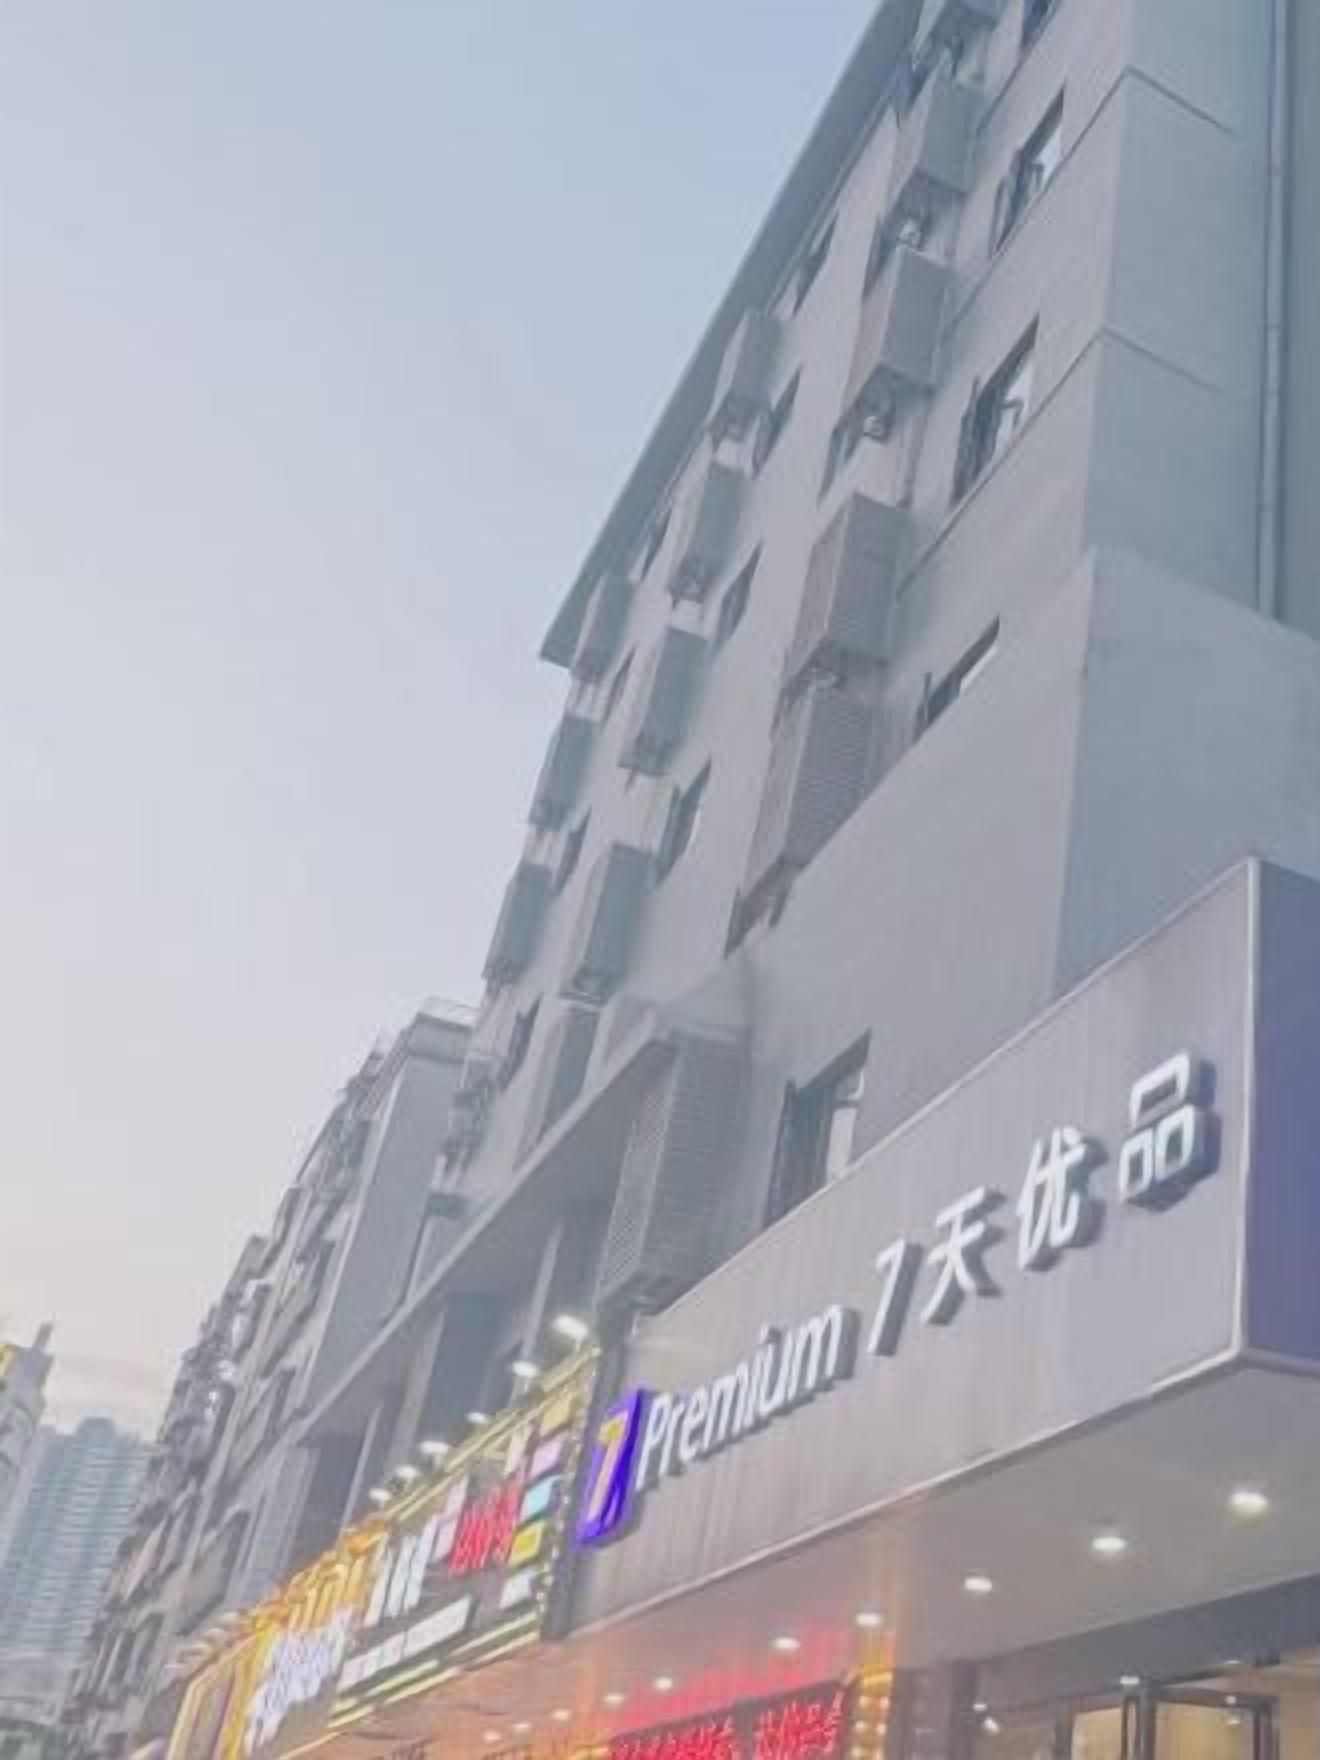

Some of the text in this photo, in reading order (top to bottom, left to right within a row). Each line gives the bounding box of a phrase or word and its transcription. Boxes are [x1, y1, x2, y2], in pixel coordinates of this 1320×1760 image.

[635, 1303, 850, 1491] Premium
[867, 1049, 1198, 1356] 7天优品
